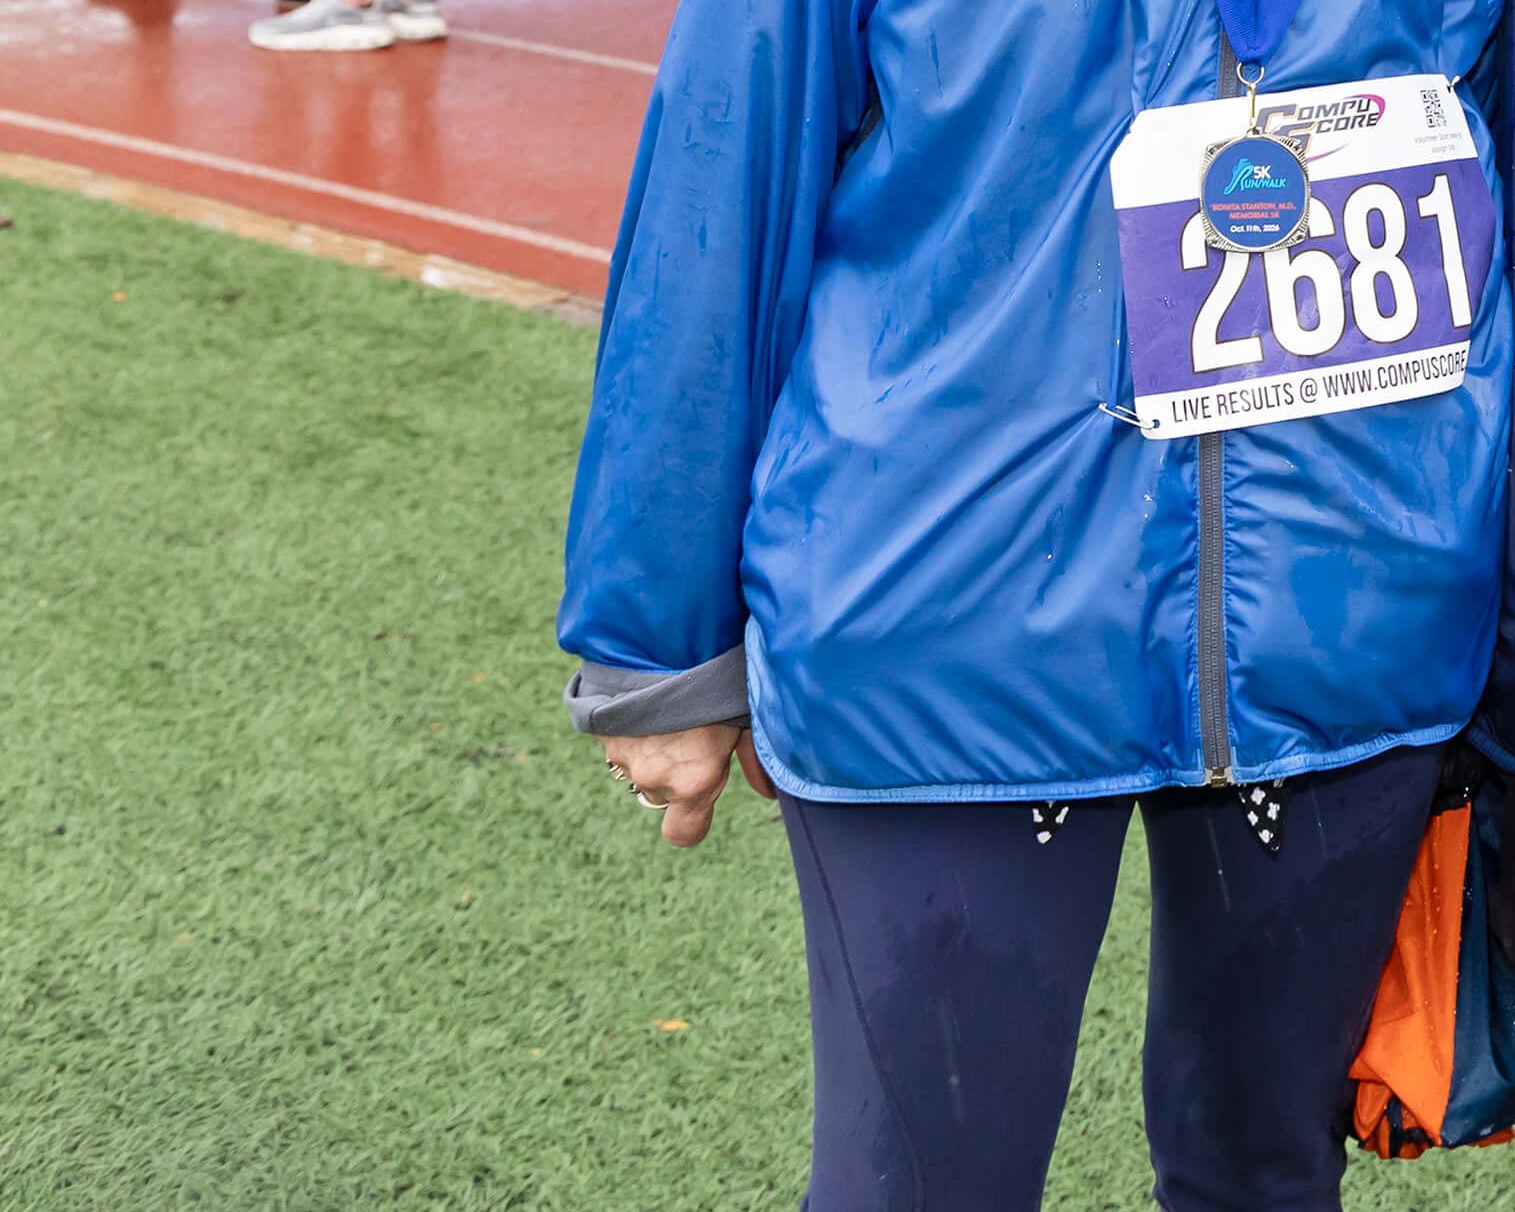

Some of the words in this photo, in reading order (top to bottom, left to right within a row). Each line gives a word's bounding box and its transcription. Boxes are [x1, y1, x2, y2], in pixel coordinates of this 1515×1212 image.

[1253, 165, 1271, 179] 5K
[1180, 173, 1473, 375] 2681
[1172, 395, 1212, 424] LIVE
[1217, 381, 1295, 416] RESULTS
[1299, 378, 1319, 404] @
[1322, 349, 1467, 398] WWW.COMPUSCORE
